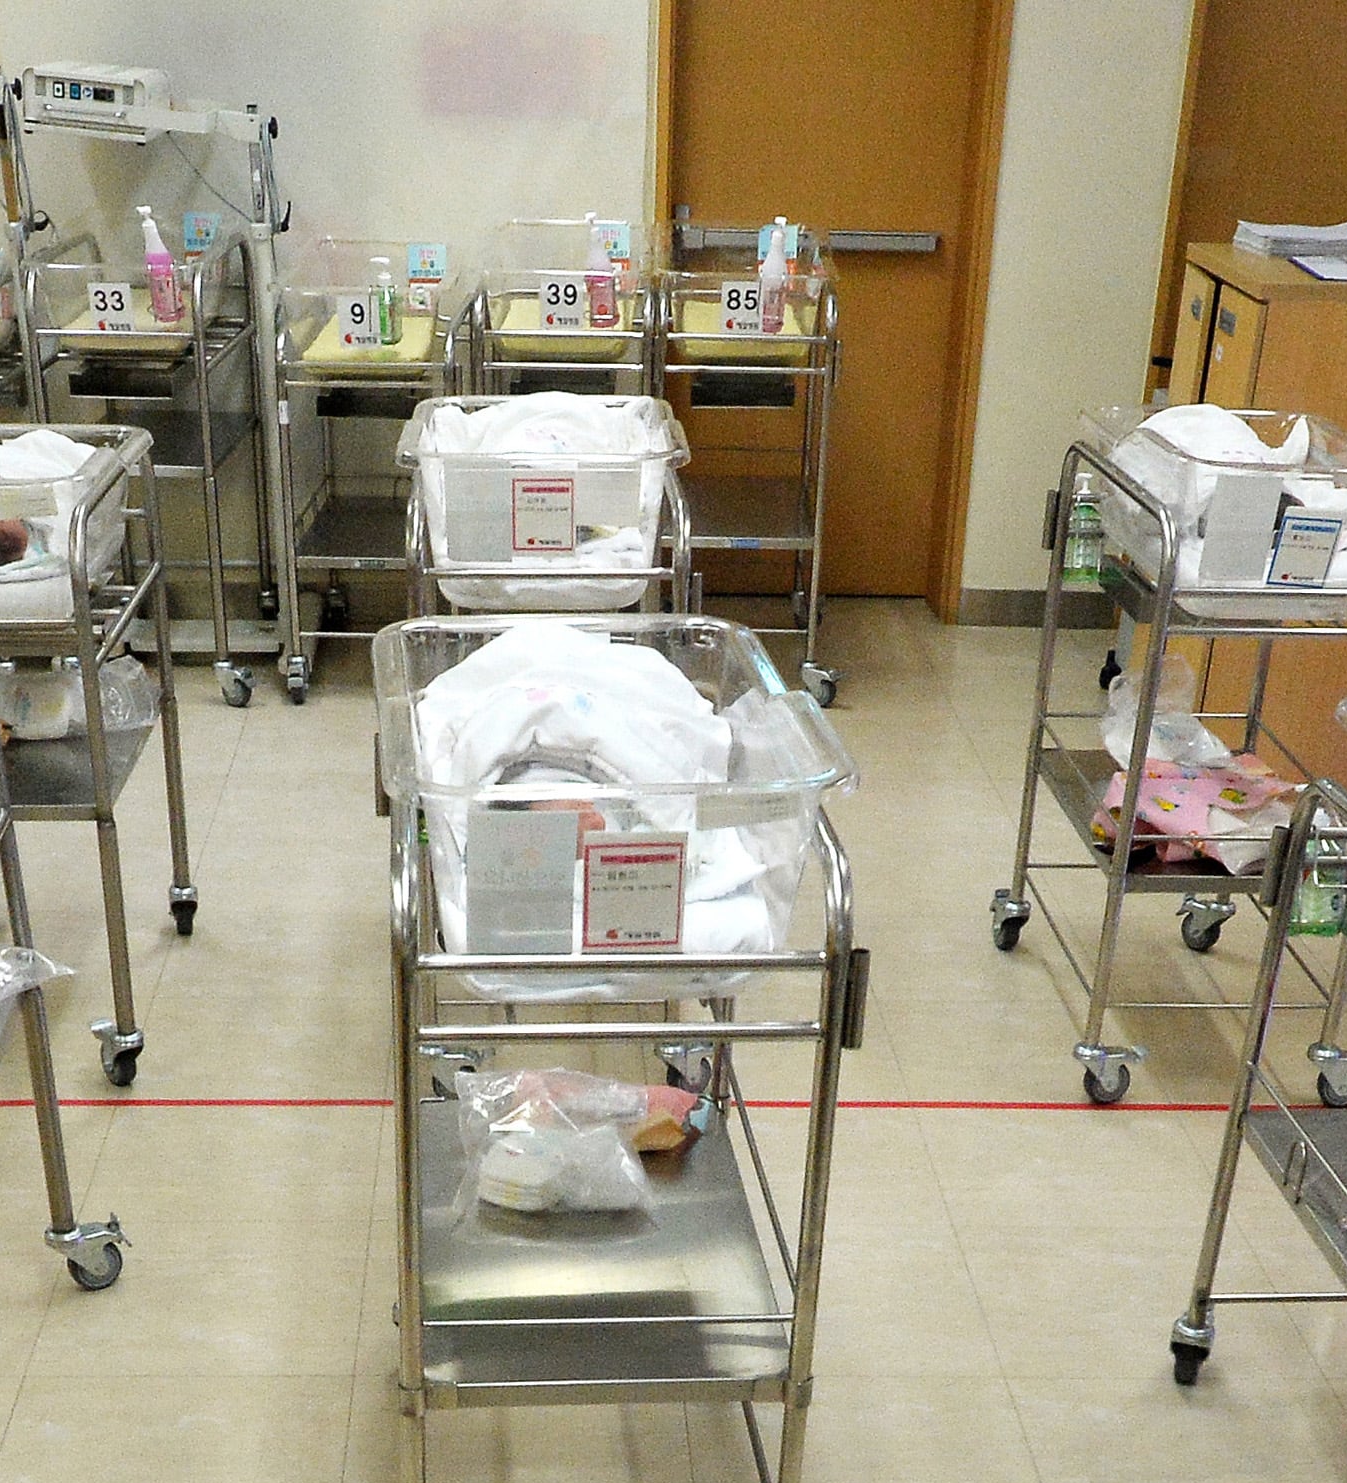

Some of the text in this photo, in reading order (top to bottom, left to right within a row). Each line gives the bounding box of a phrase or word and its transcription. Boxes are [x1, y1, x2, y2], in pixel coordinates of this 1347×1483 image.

[94, 290, 125, 311] 33
[547, 284, 578, 306] 39
[727, 288, 758, 310] 85
[351, 303, 365, 325] 9
